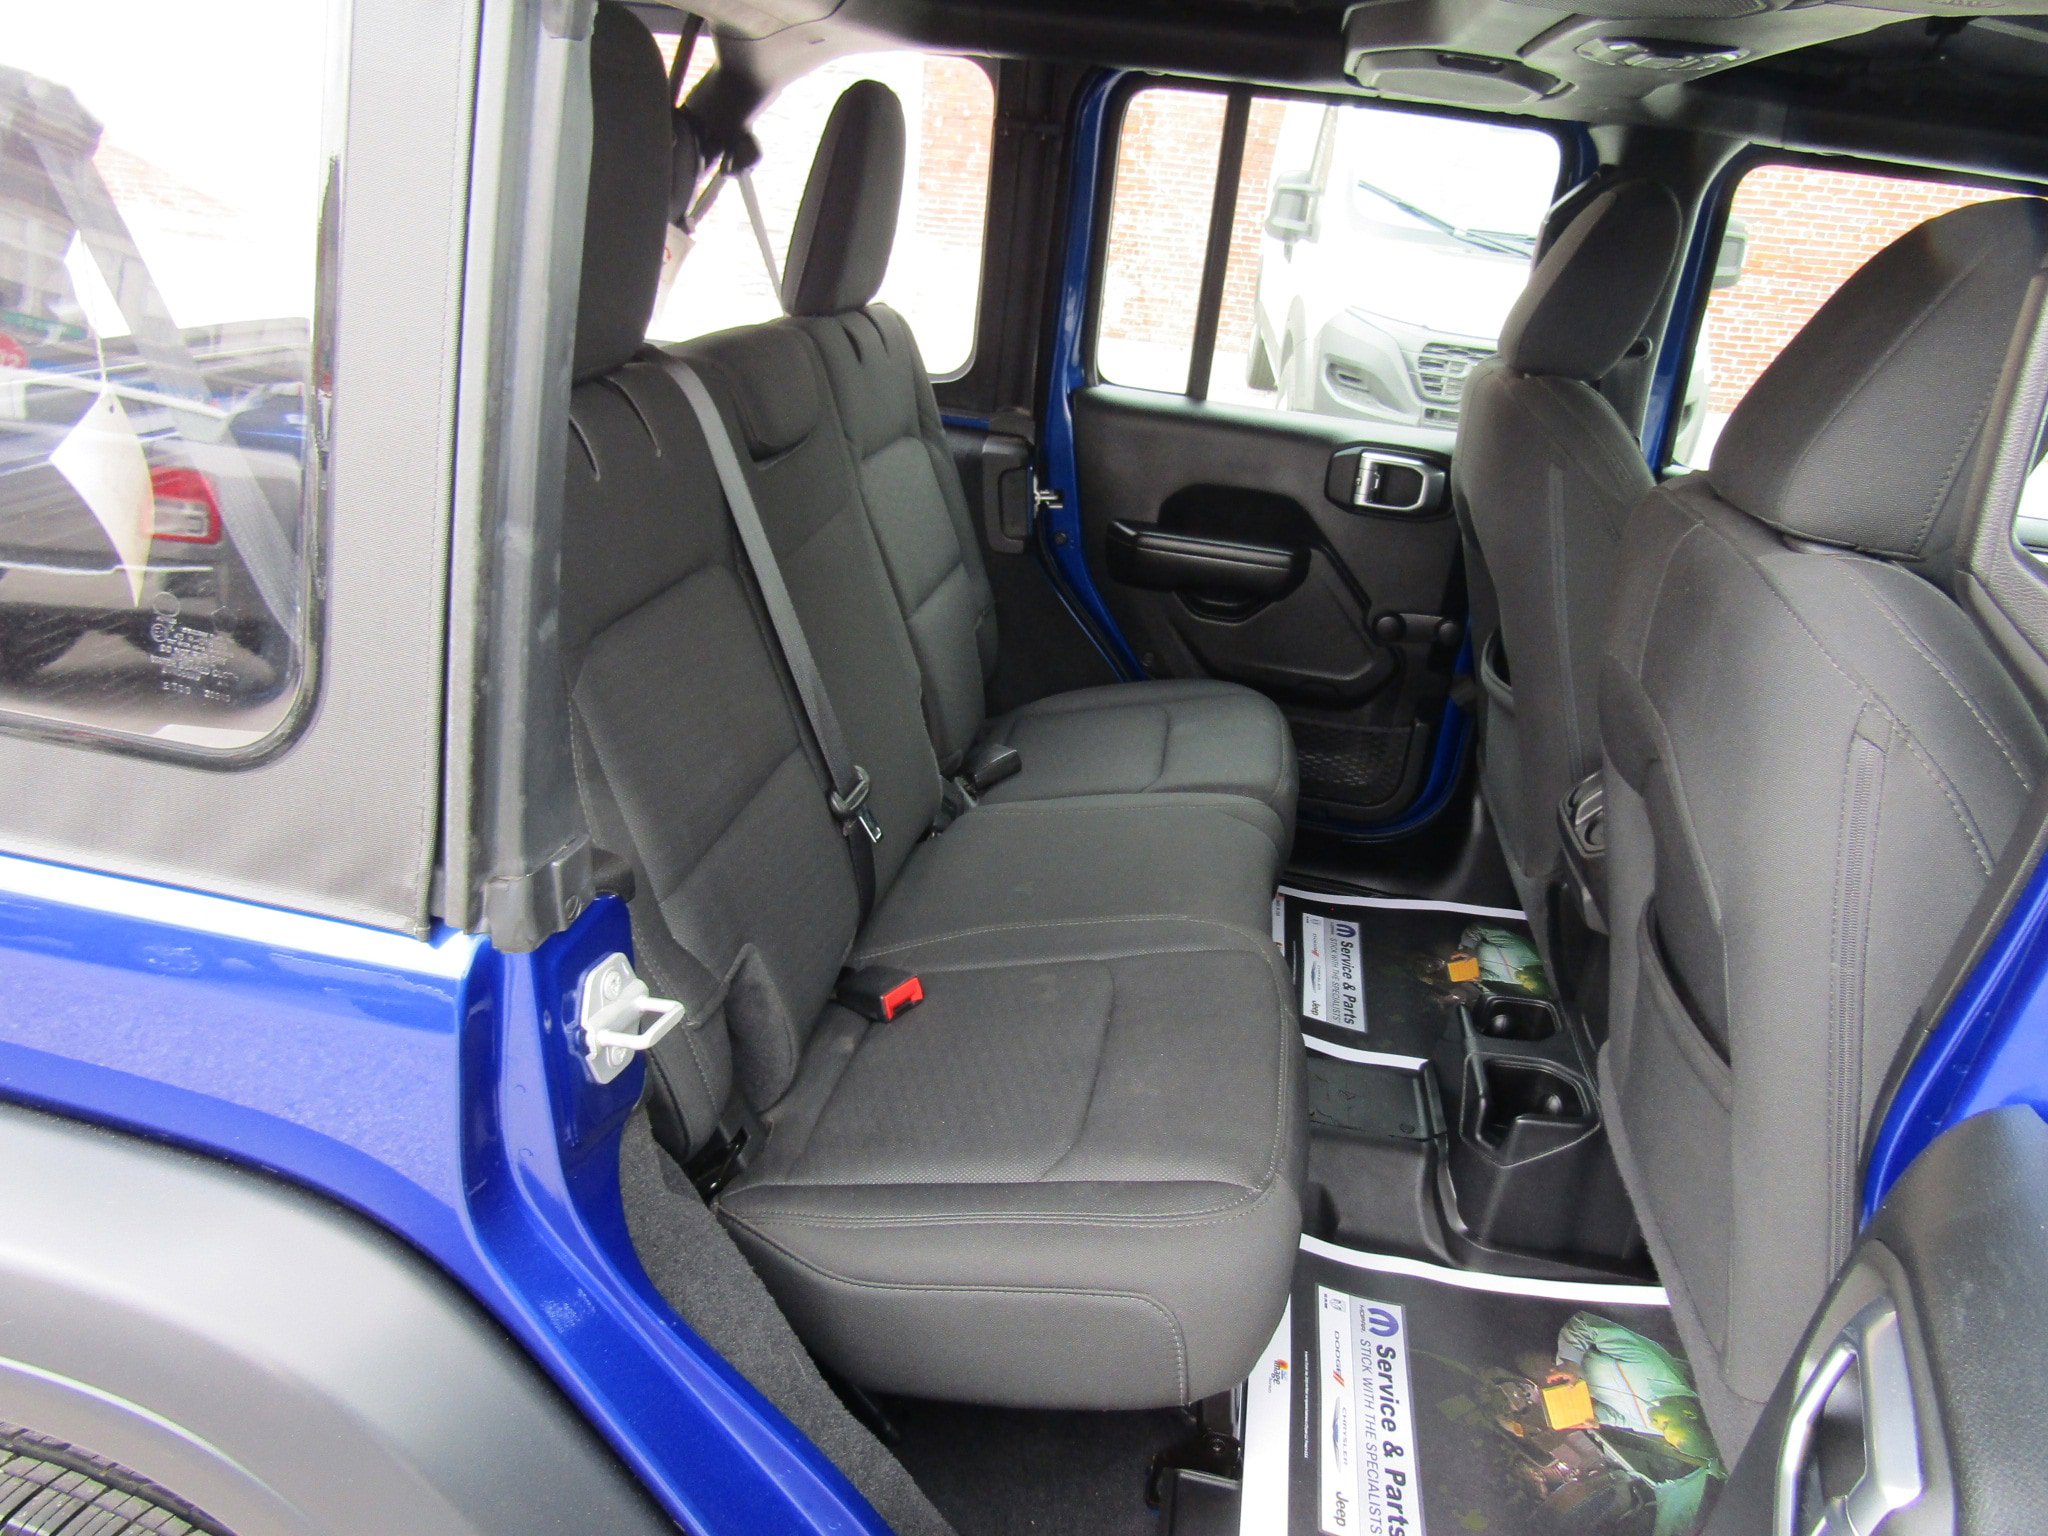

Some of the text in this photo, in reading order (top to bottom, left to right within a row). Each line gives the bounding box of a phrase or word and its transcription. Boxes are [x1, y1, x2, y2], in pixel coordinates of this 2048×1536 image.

[1329, 938, 1338, 953] STICK
[1332, 981, 1340, 1022] SPECIALISTS
[1341, 941, 1357, 1025] Service & Parts
[1311, 1000, 1320, 1015] Jeep
[1360, 1339, 1382, 1534] STICK WITH THE SPECIALISTS
[1376, 1344, 1409, 1536] Service & Parts
[1334, 1491, 1348, 1526] Jeep
